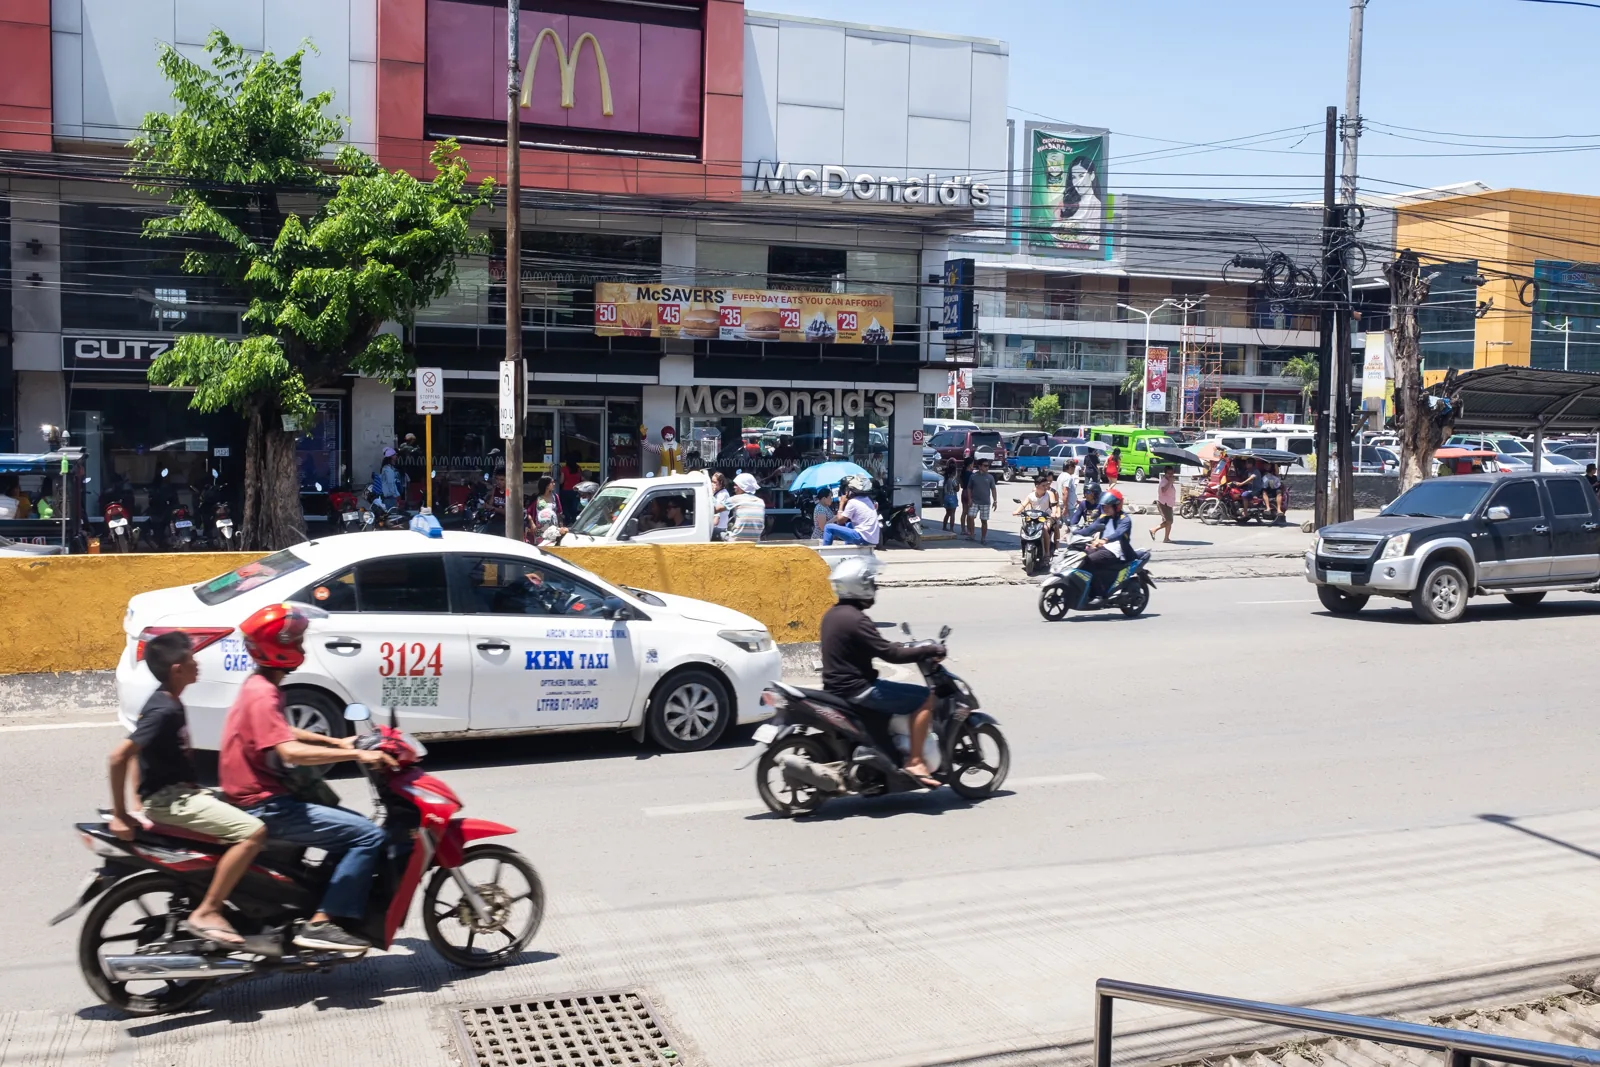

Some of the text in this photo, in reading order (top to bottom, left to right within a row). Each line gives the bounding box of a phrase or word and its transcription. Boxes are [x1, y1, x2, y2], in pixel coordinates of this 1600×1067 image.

[754, 159, 991, 207] McDonald's
[732, 293, 779, 303] EVERYDAY
[781, 295, 803, 304] EATS
[805, 297, 823, 305] YOU
[825, 298, 844, 306] CAN
[944, 305, 958, 324] 24
[1148, 359, 1167, 367] SALE
[676, 384, 895, 417] McDonald's
[500, 409, 513, 419] NO U
[501, 423, 513, 435] TURN
[379, 642, 444, 676] 3124
[525, 651, 609, 670] KEN TAXI
[536, 698, 559, 712] LTFRB
